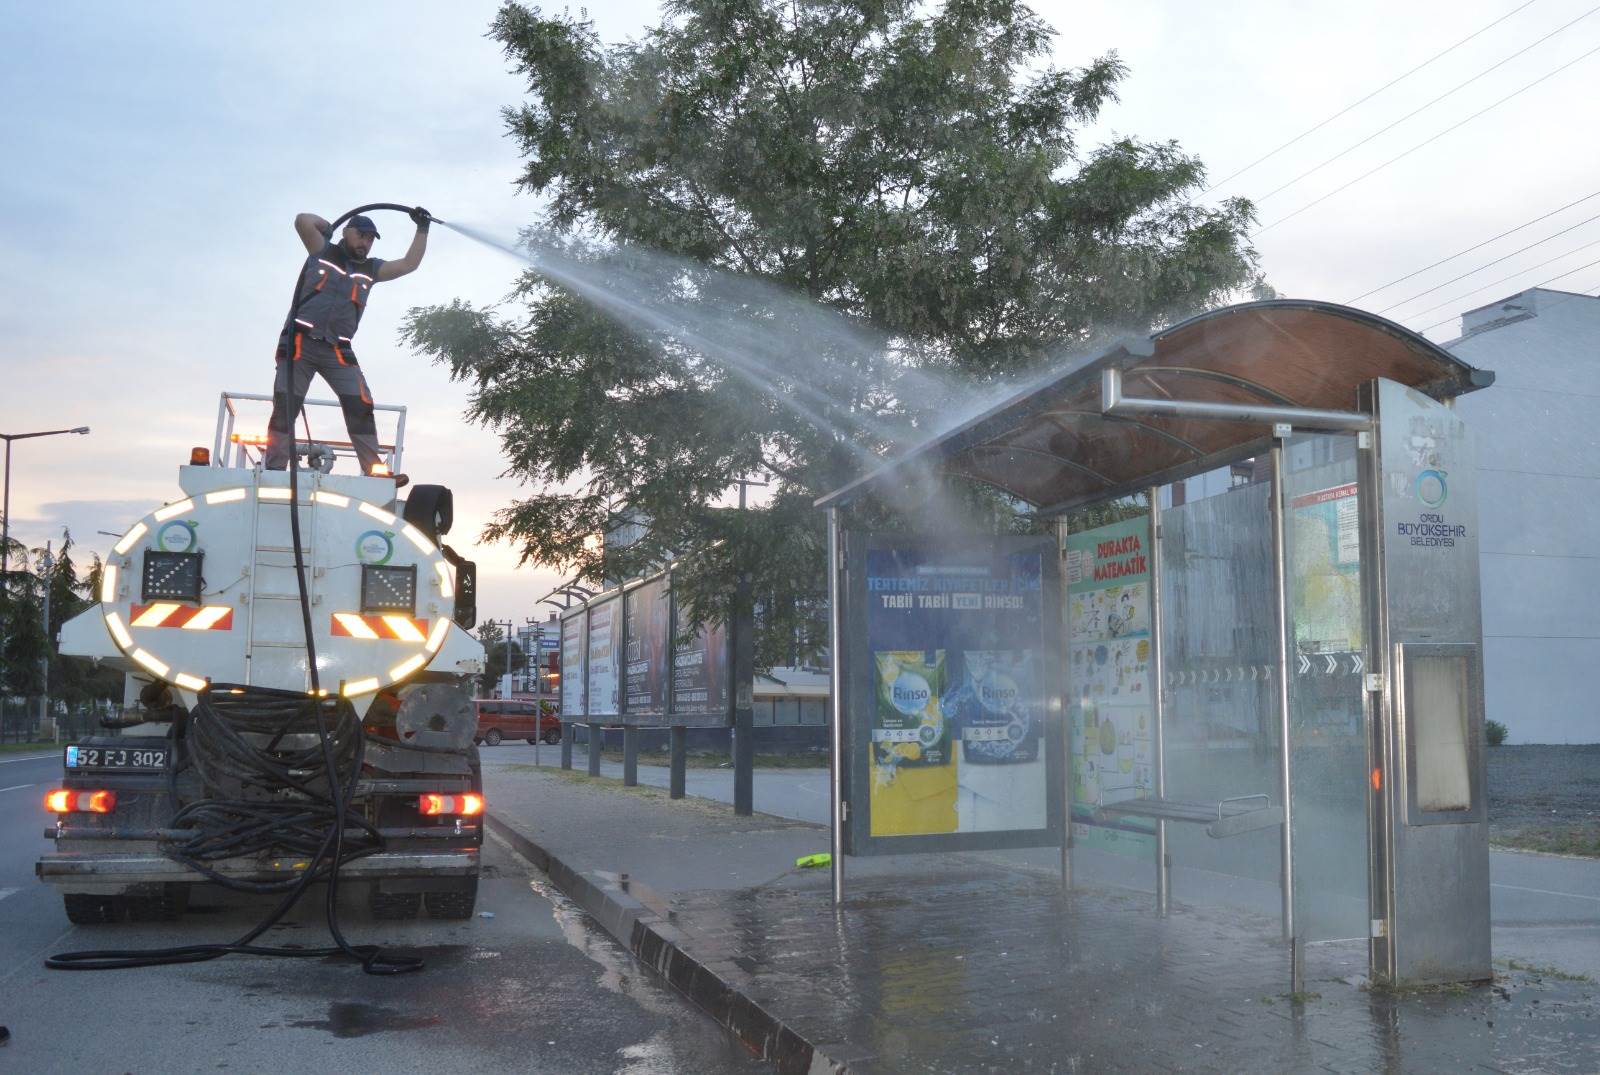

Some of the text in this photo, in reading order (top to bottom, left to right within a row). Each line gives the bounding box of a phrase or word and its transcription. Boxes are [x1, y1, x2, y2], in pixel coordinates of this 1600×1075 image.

[1420, 513, 1444, 524] ORDU
[1096, 535, 1141, 559] DURAKTA
[1093, 552, 1147, 582] MATEMATİK
[881, 592, 913, 609] TABİİ
[918, 592, 949, 609] TABİİ
[893, 686, 928, 700] Rinso
[982, 686, 1015, 700] Rinso
[78, 749, 164, 767] 52 FJ 302
